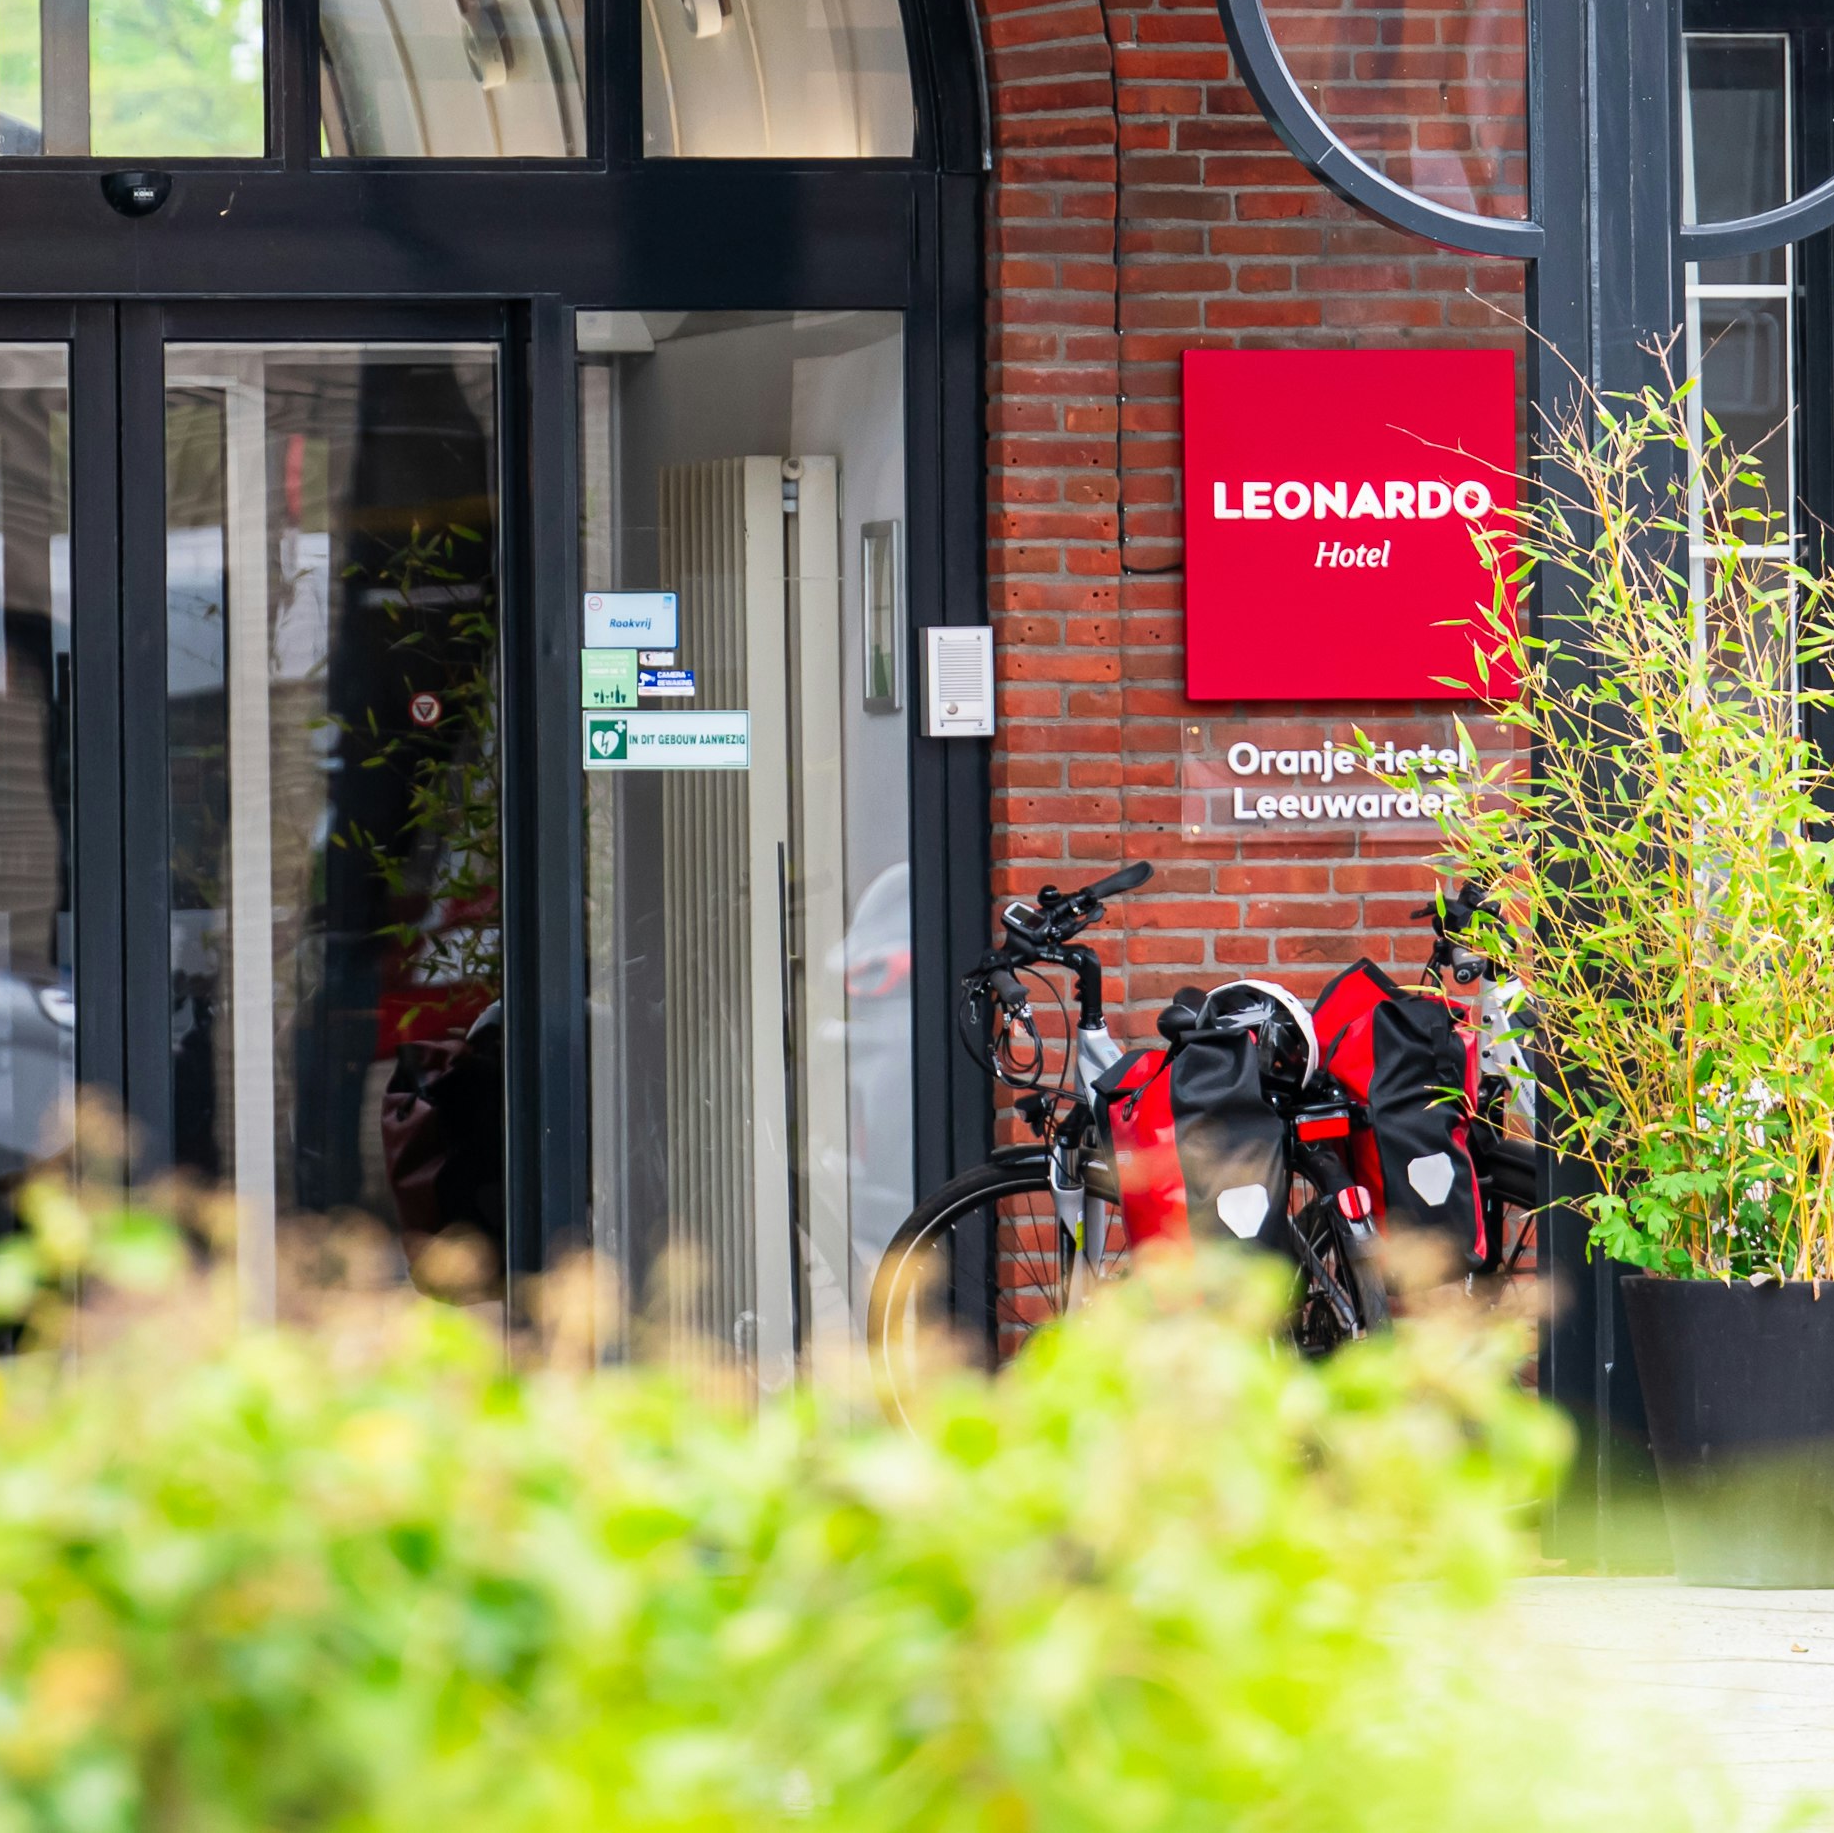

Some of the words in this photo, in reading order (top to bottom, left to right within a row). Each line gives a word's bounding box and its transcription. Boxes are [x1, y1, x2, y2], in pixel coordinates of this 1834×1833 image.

[1213, 481, 1492, 520] LEONARDO
[1313, 540, 1392, 568] Hotel
[629, 734, 638, 745] IN
[641, 734, 655, 745] DIT
[658, 734, 697, 745] GEBOUW
[699, 734, 746, 745] AANWEZIG
[1227, 741, 1356, 783] Oranje
